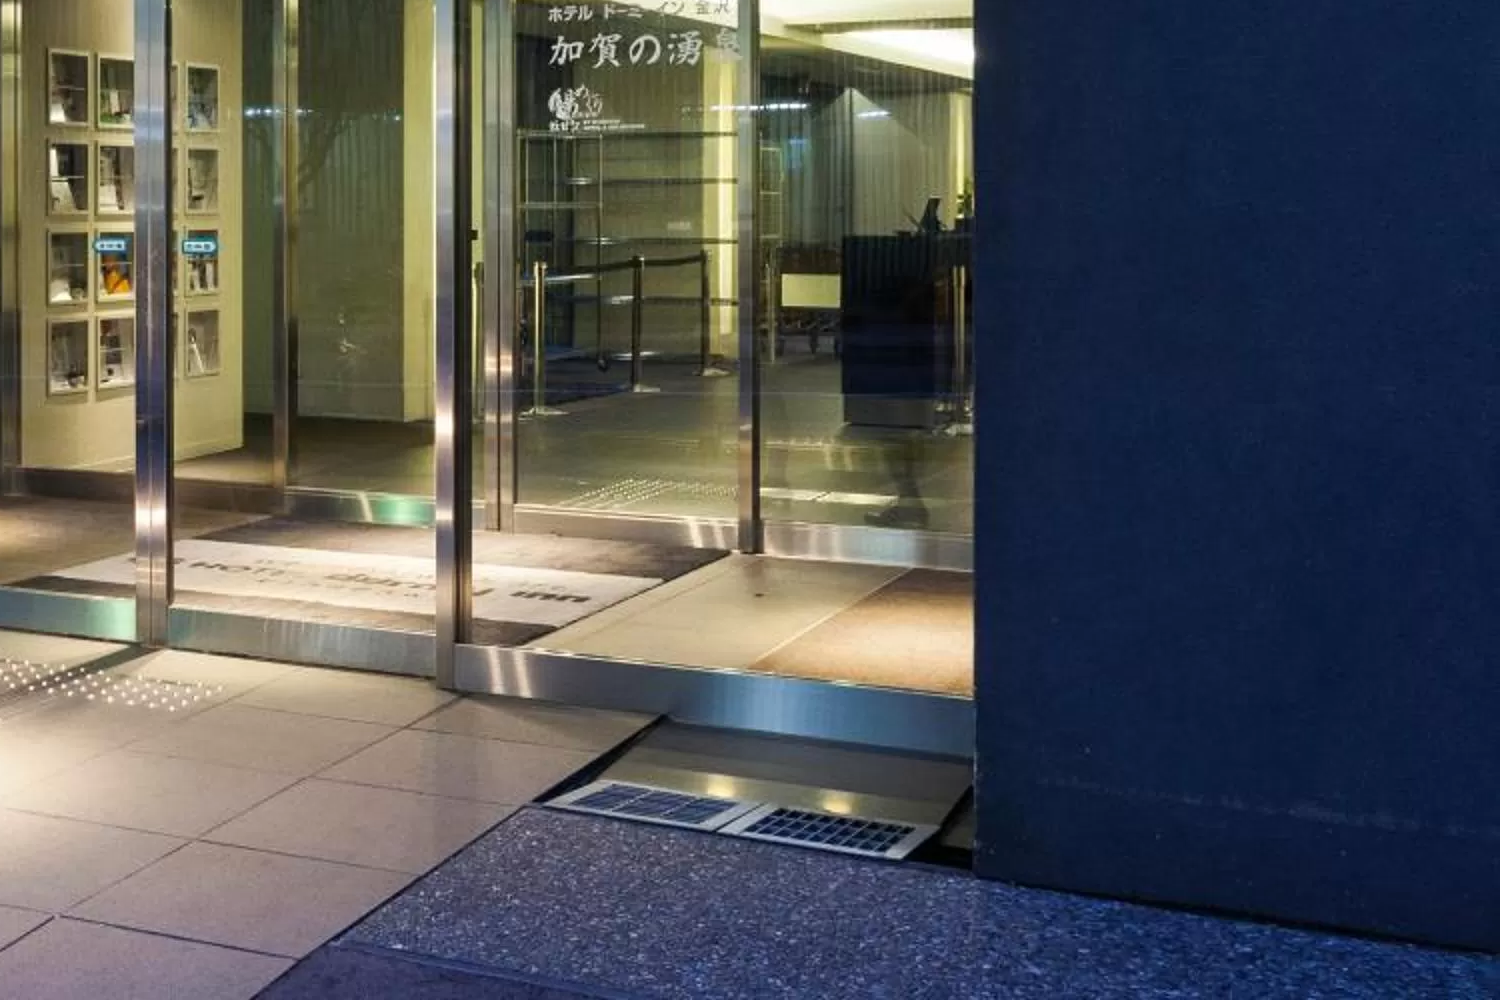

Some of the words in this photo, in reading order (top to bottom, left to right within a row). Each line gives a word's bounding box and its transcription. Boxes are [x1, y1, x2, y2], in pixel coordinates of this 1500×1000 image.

[548, 4, 593, 22] ホテル
[548, 29, 743, 69] 加賀の湧泉
